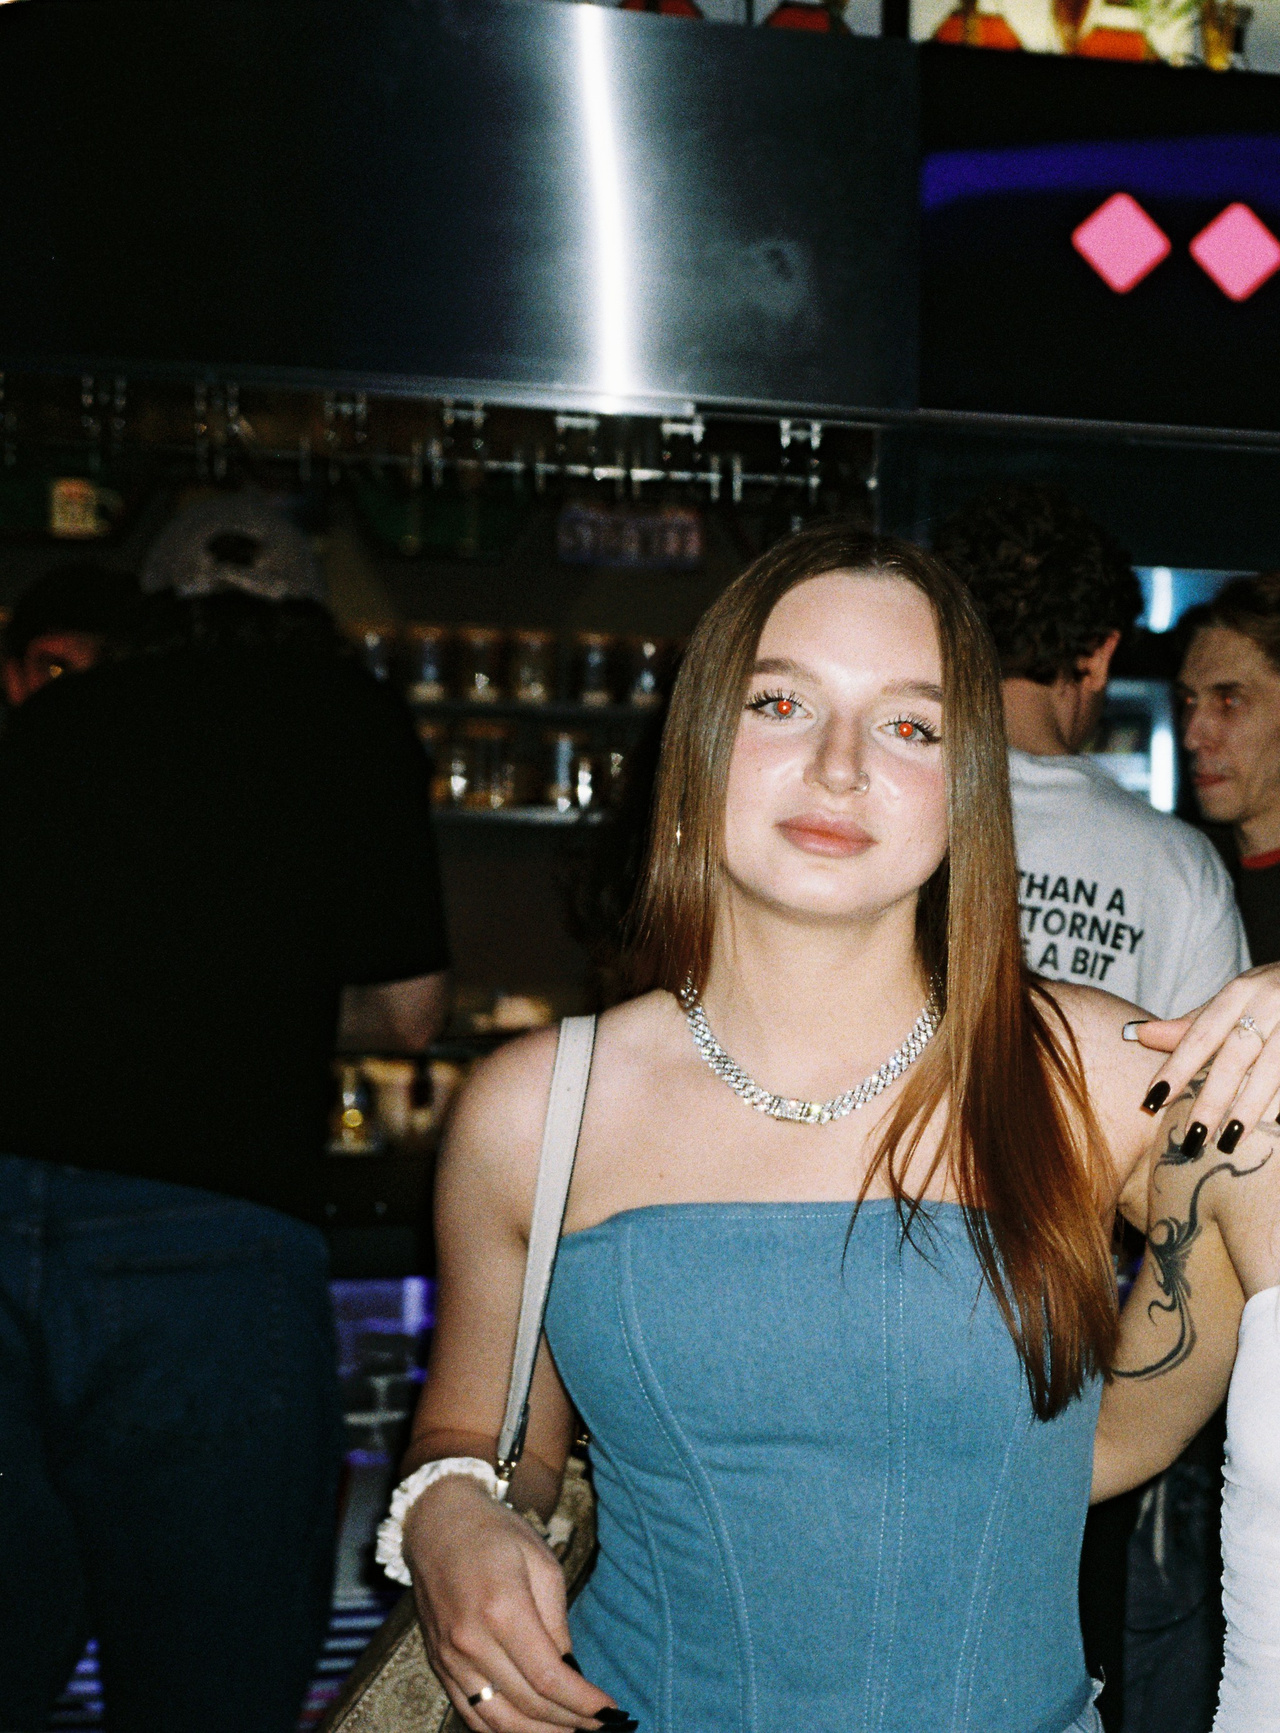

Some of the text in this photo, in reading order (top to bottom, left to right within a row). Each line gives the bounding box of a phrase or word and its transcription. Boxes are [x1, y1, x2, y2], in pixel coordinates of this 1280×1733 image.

[1106, 887, 1125, 916] A
[1019, 904, 1144, 955] TORNEY
[1038, 942, 1059, 970] A
[1071, 946, 1115, 981] BIT
